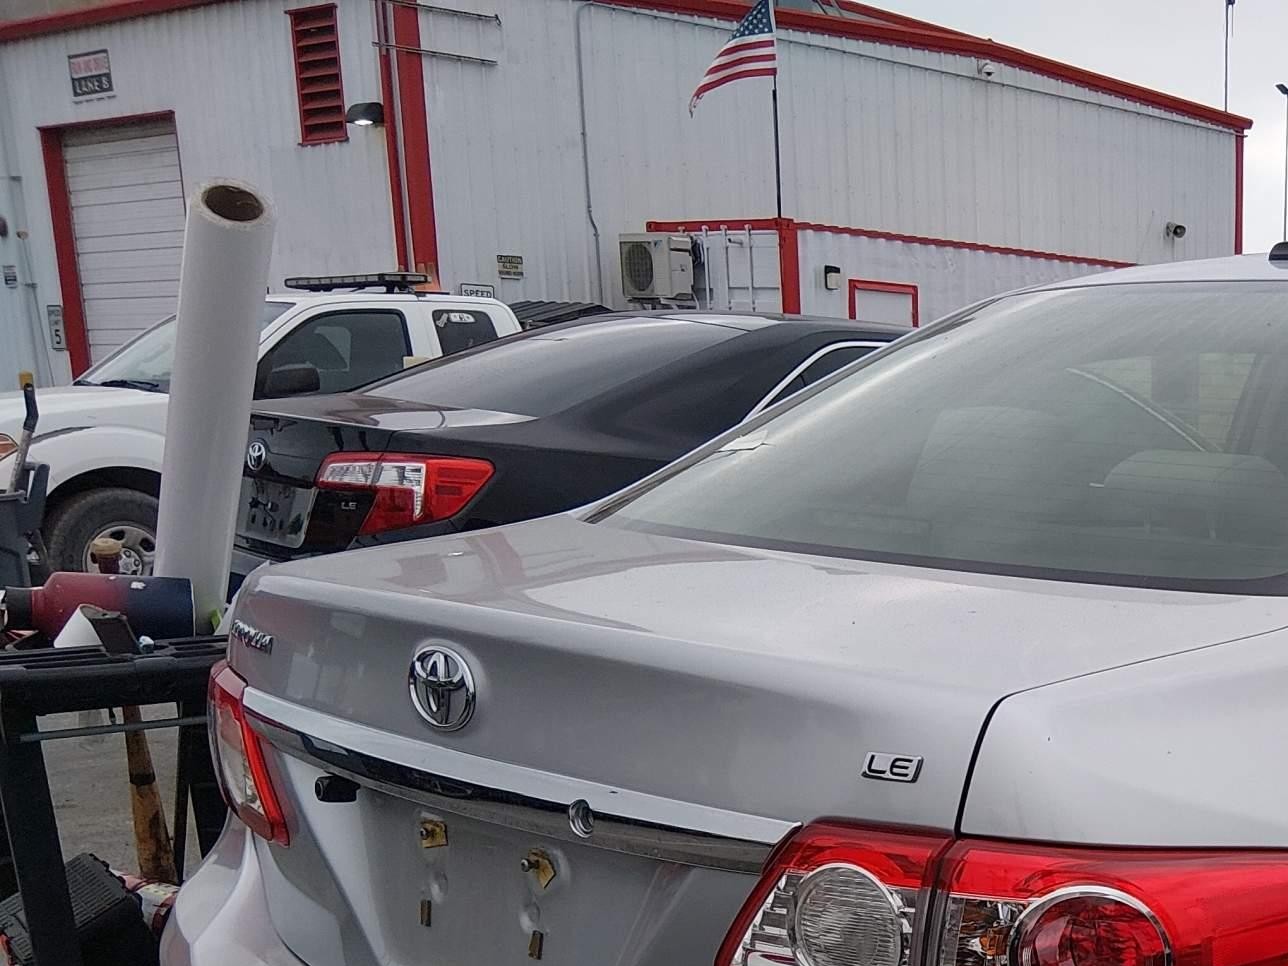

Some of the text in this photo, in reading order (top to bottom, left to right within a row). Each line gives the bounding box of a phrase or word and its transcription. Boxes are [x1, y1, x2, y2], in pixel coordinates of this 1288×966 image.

[463, 289, 493, 299] SPEED
[54, 328, 62, 345] 5
[864, 752, 919, 780] LE
